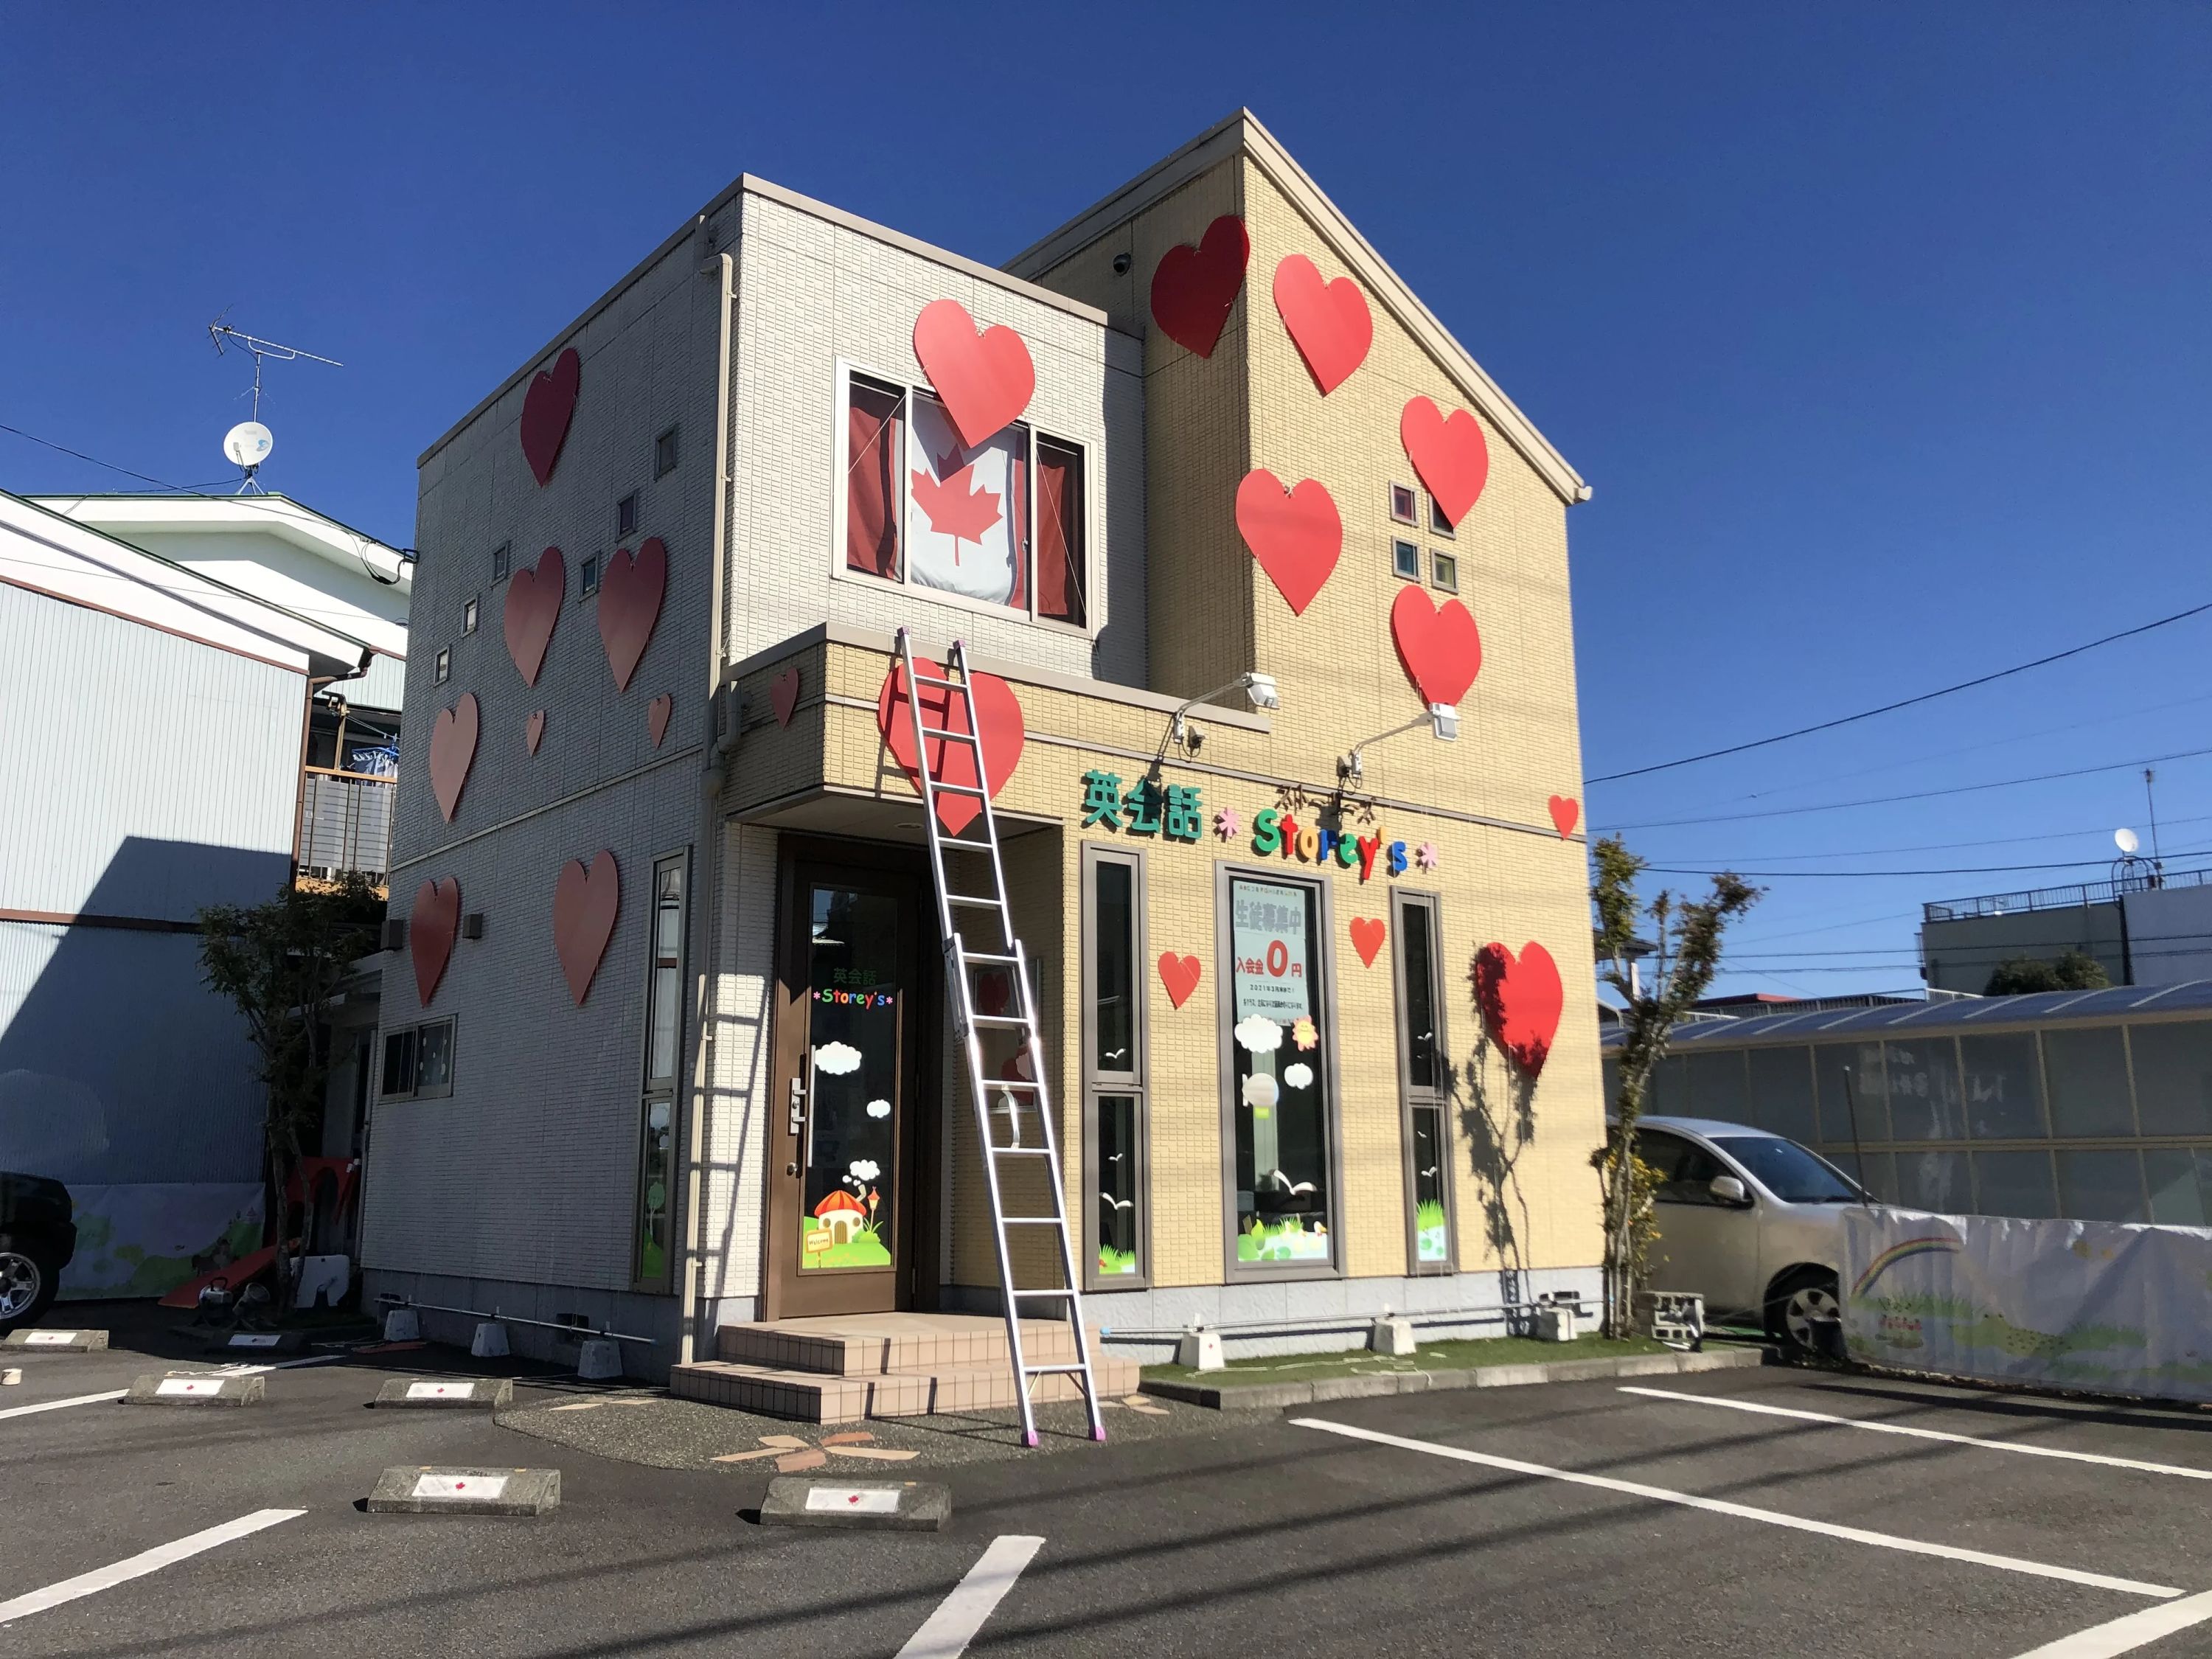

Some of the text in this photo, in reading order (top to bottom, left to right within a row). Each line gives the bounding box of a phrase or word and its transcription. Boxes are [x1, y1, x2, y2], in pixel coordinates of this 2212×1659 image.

[1085, 769, 1203, 839] 英会話
[1255, 808, 1408, 880] Storey's
[1235, 900, 1301, 934] 生徒募集中
[833, 967, 877, 986] 英会話
[822, 989, 885, 1009] Storey's
